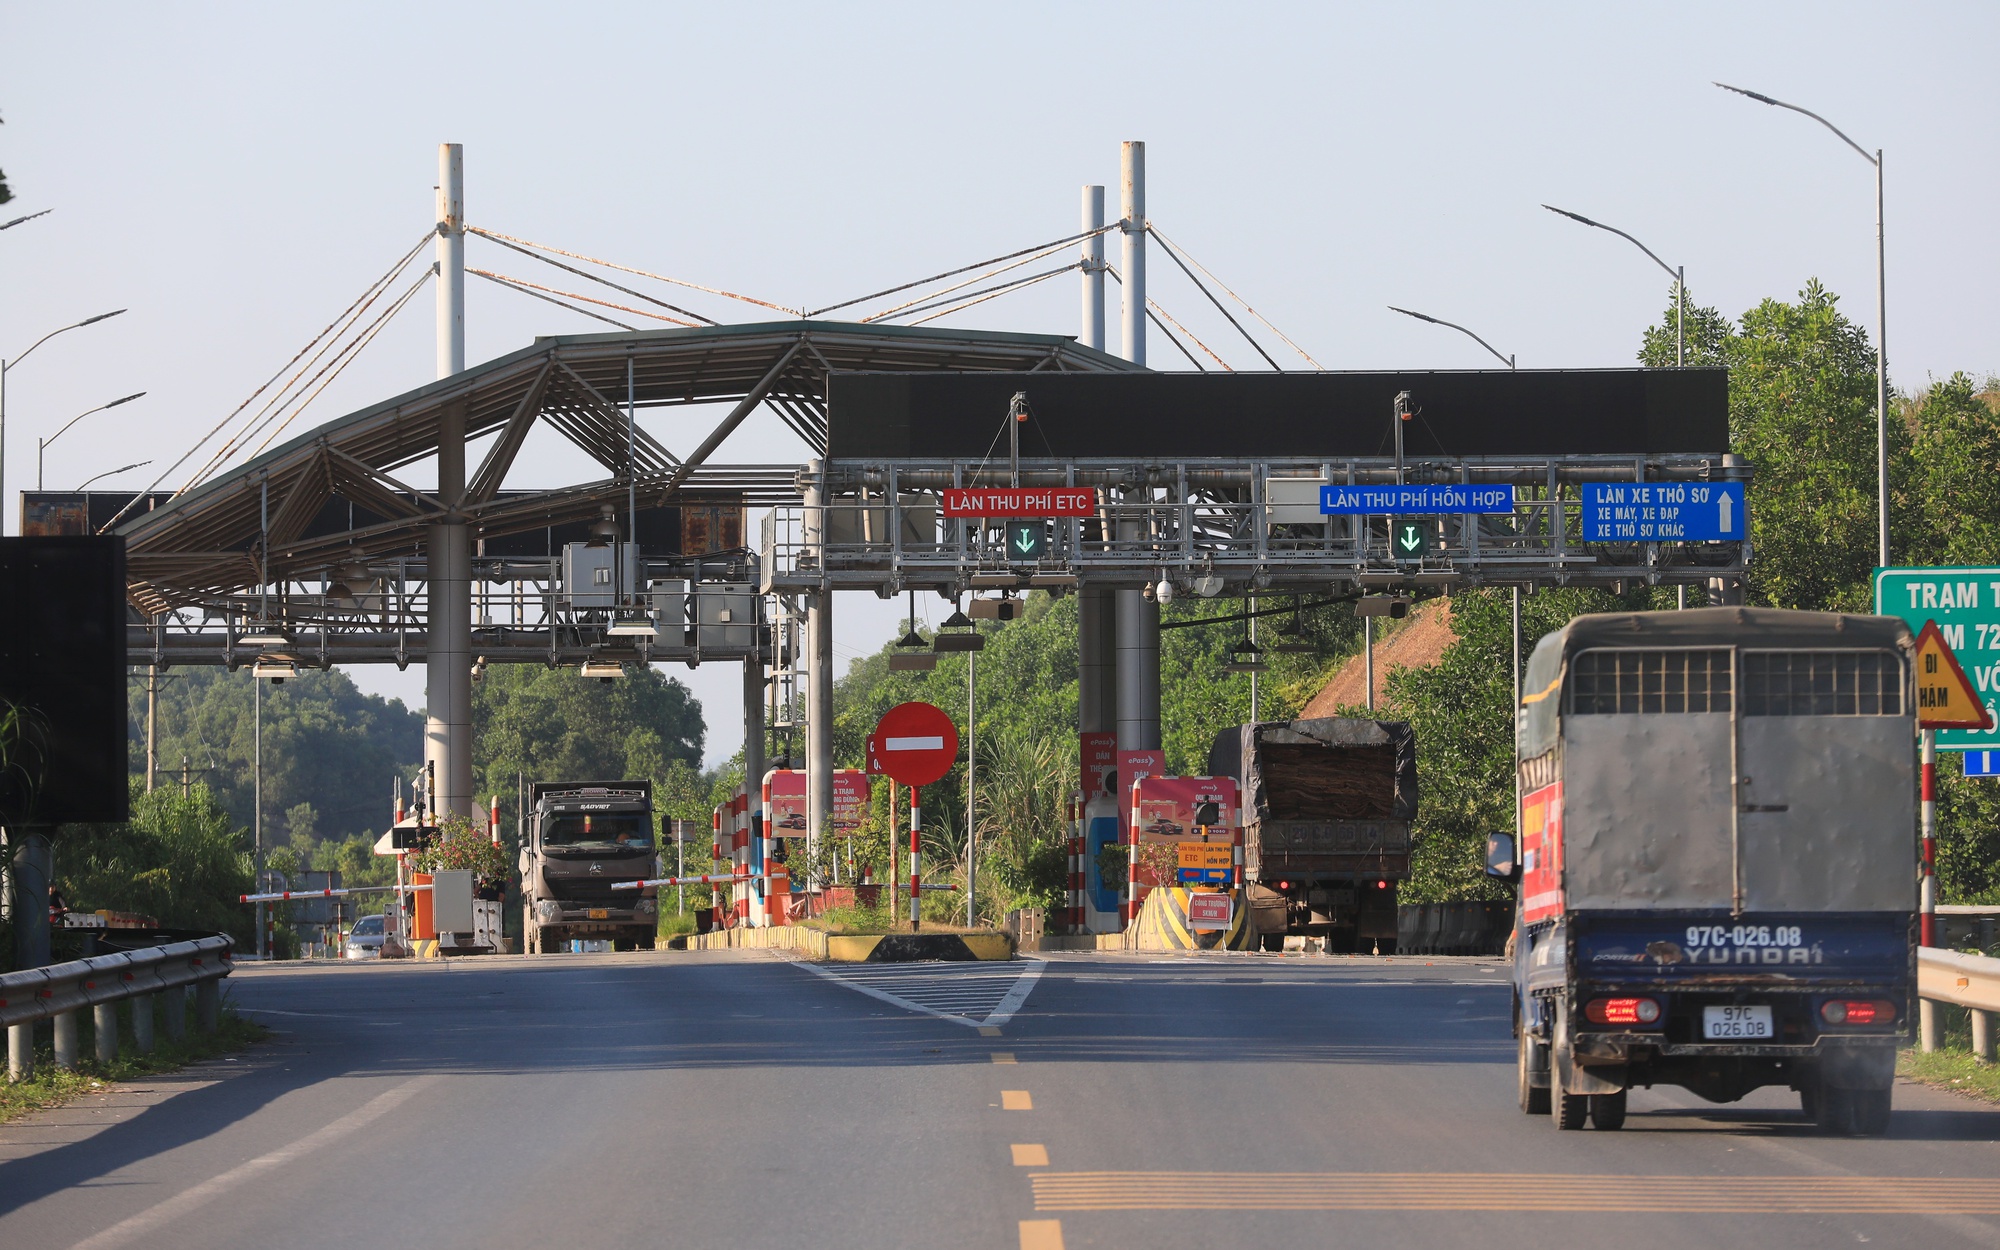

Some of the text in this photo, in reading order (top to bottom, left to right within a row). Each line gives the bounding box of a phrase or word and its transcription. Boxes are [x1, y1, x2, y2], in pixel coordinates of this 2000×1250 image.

[950, 491, 1087, 510] LÀN THU PHÍ ETC
[1327, 486, 1506, 509] LÀN THU PHÍ HỖN HỢP
[1596, 484, 1710, 504] LÀN XE THÔ SƠ
[1597, 505, 1679, 522] XE MÁY, XE ĐẠP
[1597, 522, 1685, 537] XE THÔ SƠ KHÁC
[1906, 582, 1978, 614] TRẠM
[1925, 653, 1938, 674] ĐI
[1919, 683, 1948, 711] HẬM
[1185, 854, 1198, 862] ETC
[1685, 926, 1802, 947] 97C-026.08
[1723, 1007, 1753, 1021] 97C
[1712, 1022, 1766, 1036] 026.08
